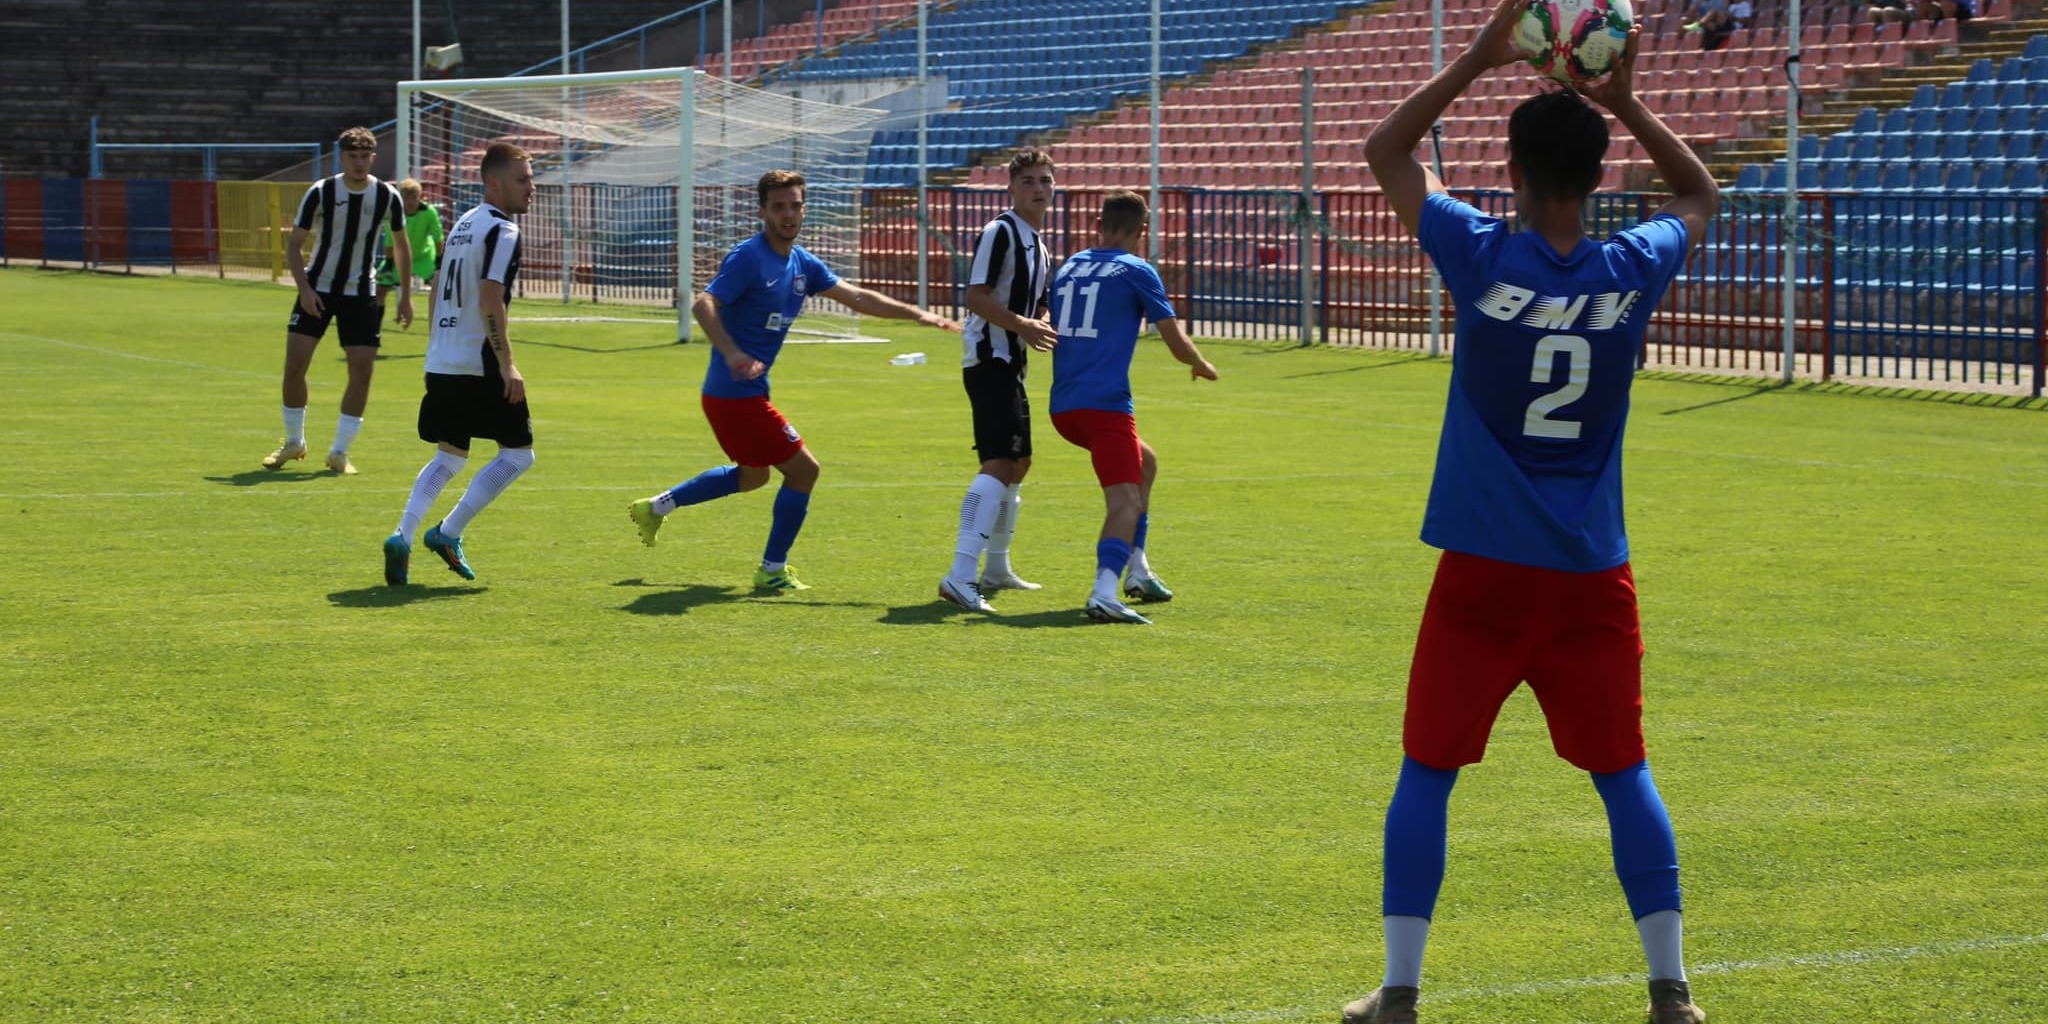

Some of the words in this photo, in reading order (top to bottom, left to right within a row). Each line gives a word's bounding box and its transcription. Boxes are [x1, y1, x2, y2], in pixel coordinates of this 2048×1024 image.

[1056, 280, 1101, 339] 11
[1473, 281, 1638, 330] BMV
[1522, 335, 1591, 439] 2
